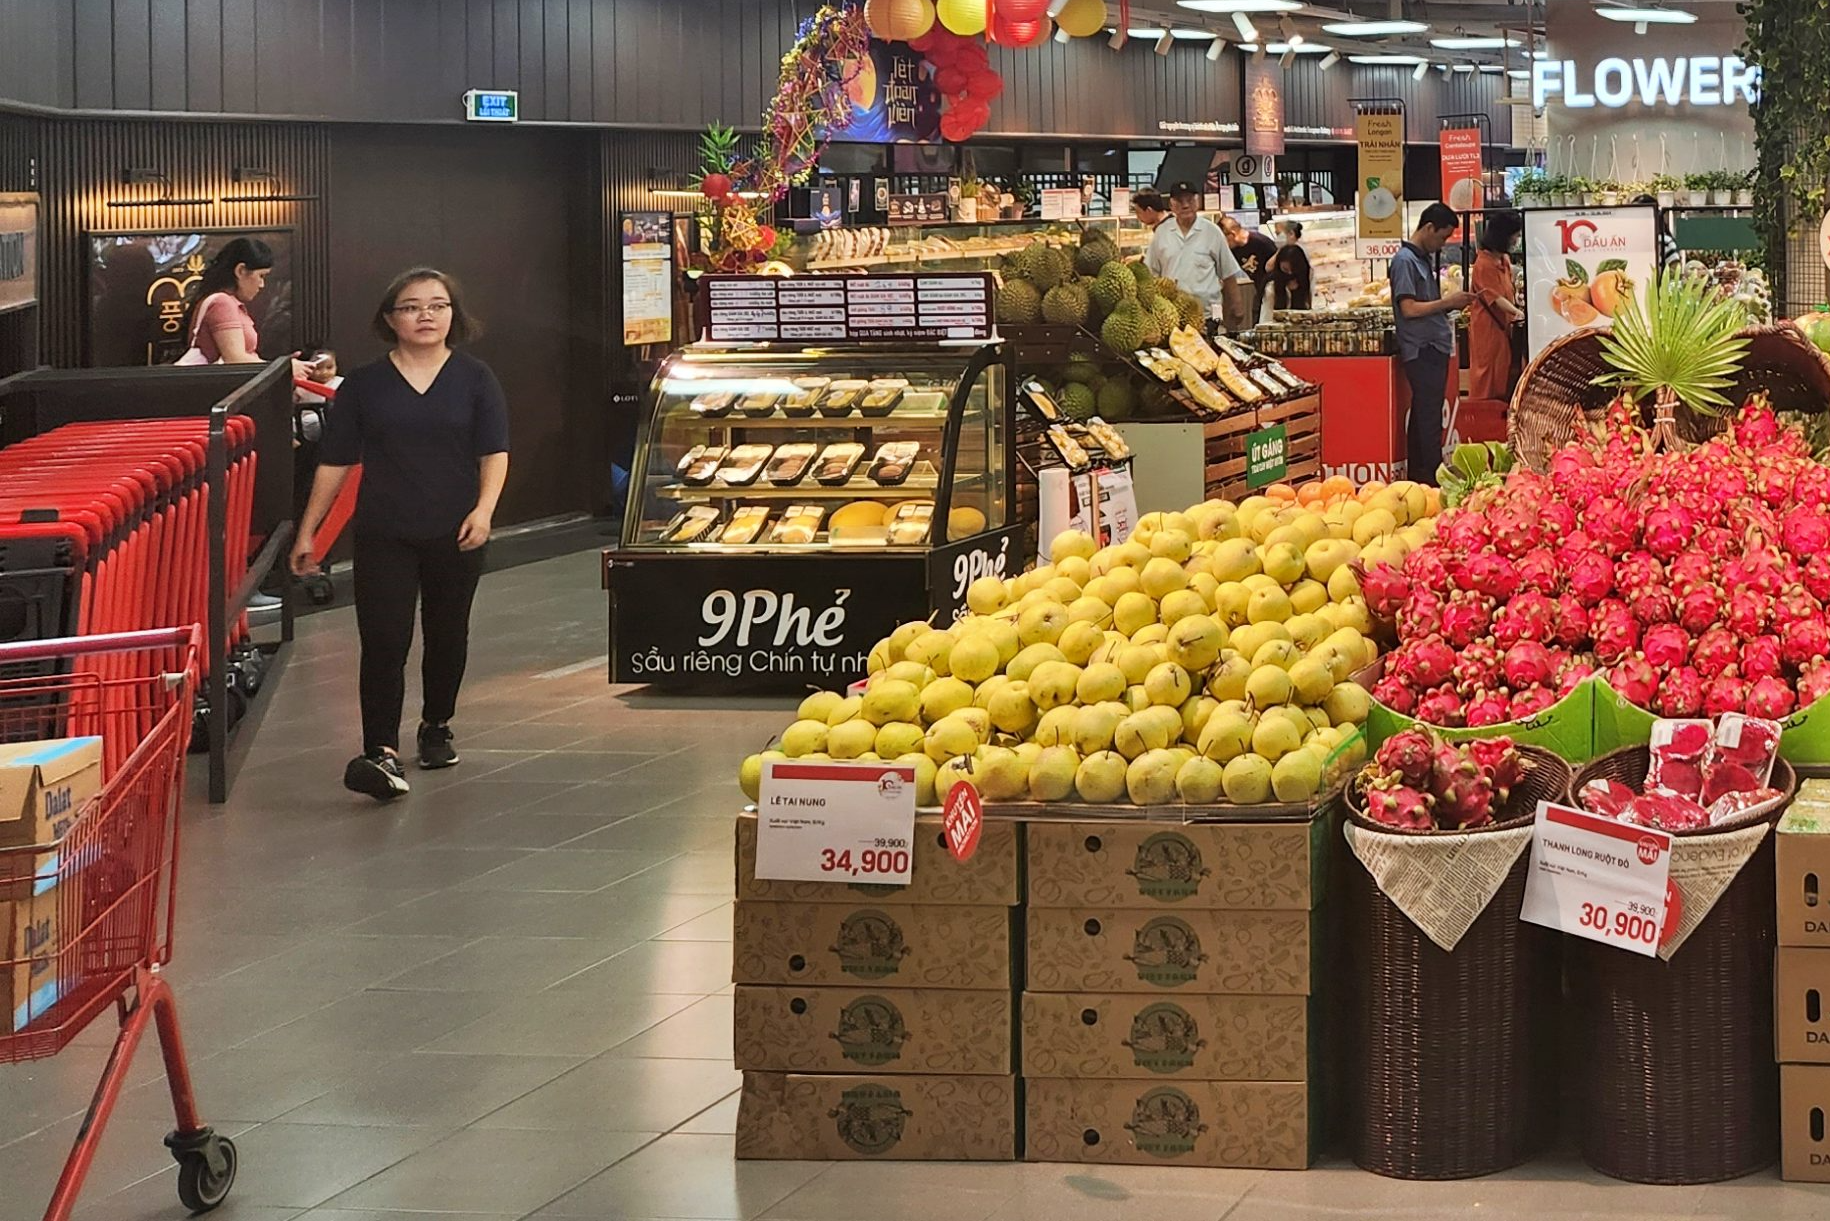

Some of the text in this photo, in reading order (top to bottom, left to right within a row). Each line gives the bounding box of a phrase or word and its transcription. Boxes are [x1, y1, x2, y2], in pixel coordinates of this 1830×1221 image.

[482, 95, 507, 107] EXIT
[698, 588, 852, 647] 9Phẻ
[632, 646, 836, 677] Sầu riêng Chín tự
[45, 785, 72, 820] Dalat
[770, 795, 782, 806] LÊ
[820, 848, 909, 876] 34,900
[1542, 838, 1630, 869] THANH LONG RUỘT ĐỎ
[1579, 902, 1657, 944] 30,900
